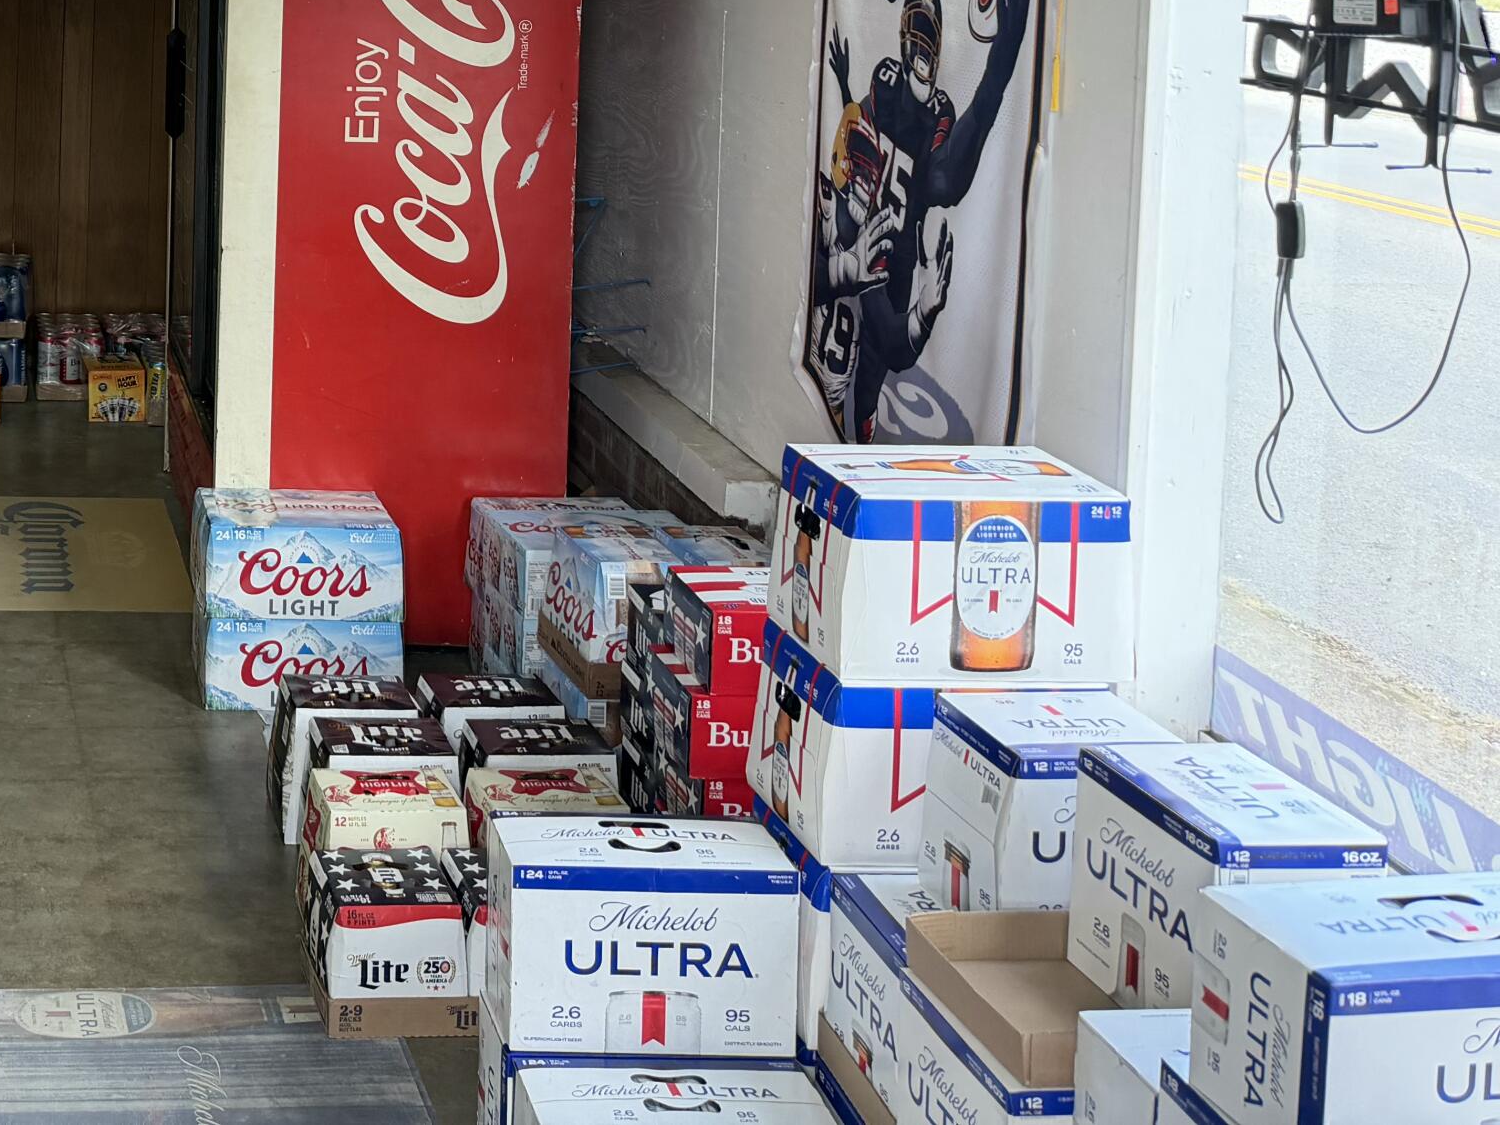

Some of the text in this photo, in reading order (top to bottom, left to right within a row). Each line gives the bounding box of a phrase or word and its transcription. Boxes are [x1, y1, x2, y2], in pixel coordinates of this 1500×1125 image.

[345, 37, 390, 144] Enjoy
[215, 530, 246, 541] 24 16
[350, 531, 373, 544] Cold
[3, 501, 85, 595] Corona
[969, 550, 1021, 565] Michelob
[238, 548, 371, 598] Coors
[961, 567, 1032, 585] ULTRA
[268, 598, 340, 617] LIGHT
[545, 561, 598, 641] Coors
[717, 615, 732, 625] 18
[896, 642, 920, 656] 2.6
[1063, 643, 1083, 657] 95
[239, 639, 369, 688] Coors
[895, 656, 920, 664] CARBS
[359, 779, 416, 790] HIGH LIFE
[540, 825, 738, 843] Michelob ULTRA
[1099, 816, 1175, 889] Michelob
[1085, 836, 1195, 954] ULTRA
[588, 900, 720, 933] Michelob
[423, 959, 451, 975] 250
[564, 938, 755, 980] ULTRA
[357, 958, 411, 991] Lite
[551, 1005, 582, 1020] 2.6
[830, 950, 899, 1063] ULTRA
[549, 1020, 583, 1028] CARBS
[725, 1009, 751, 1023] 95
[1243, 971, 1272, 1109] ULTRA
